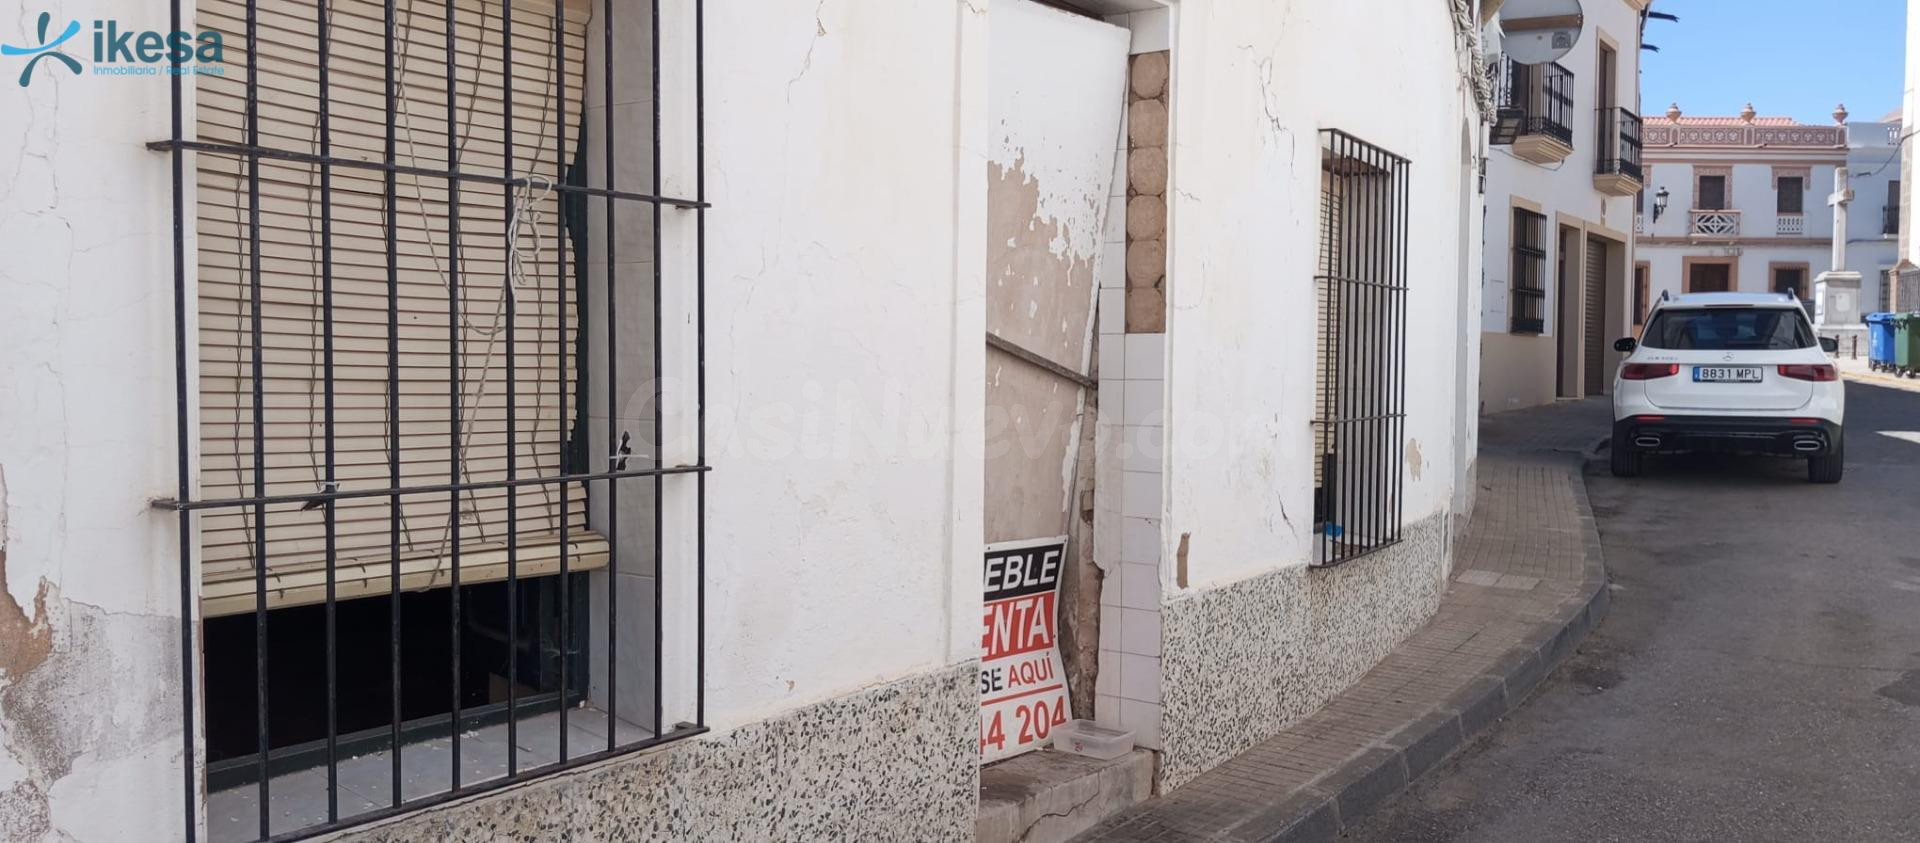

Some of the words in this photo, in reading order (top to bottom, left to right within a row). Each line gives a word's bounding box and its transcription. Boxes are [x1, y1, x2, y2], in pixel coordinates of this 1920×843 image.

[1702, 368, 1731, 378] 8831
[1736, 368, 1759, 379] MPL
[984, 550, 1059, 592] EBLE
[1008, 651, 1054, 689] AQUÍ
[1015, 695, 1067, 745] 204
